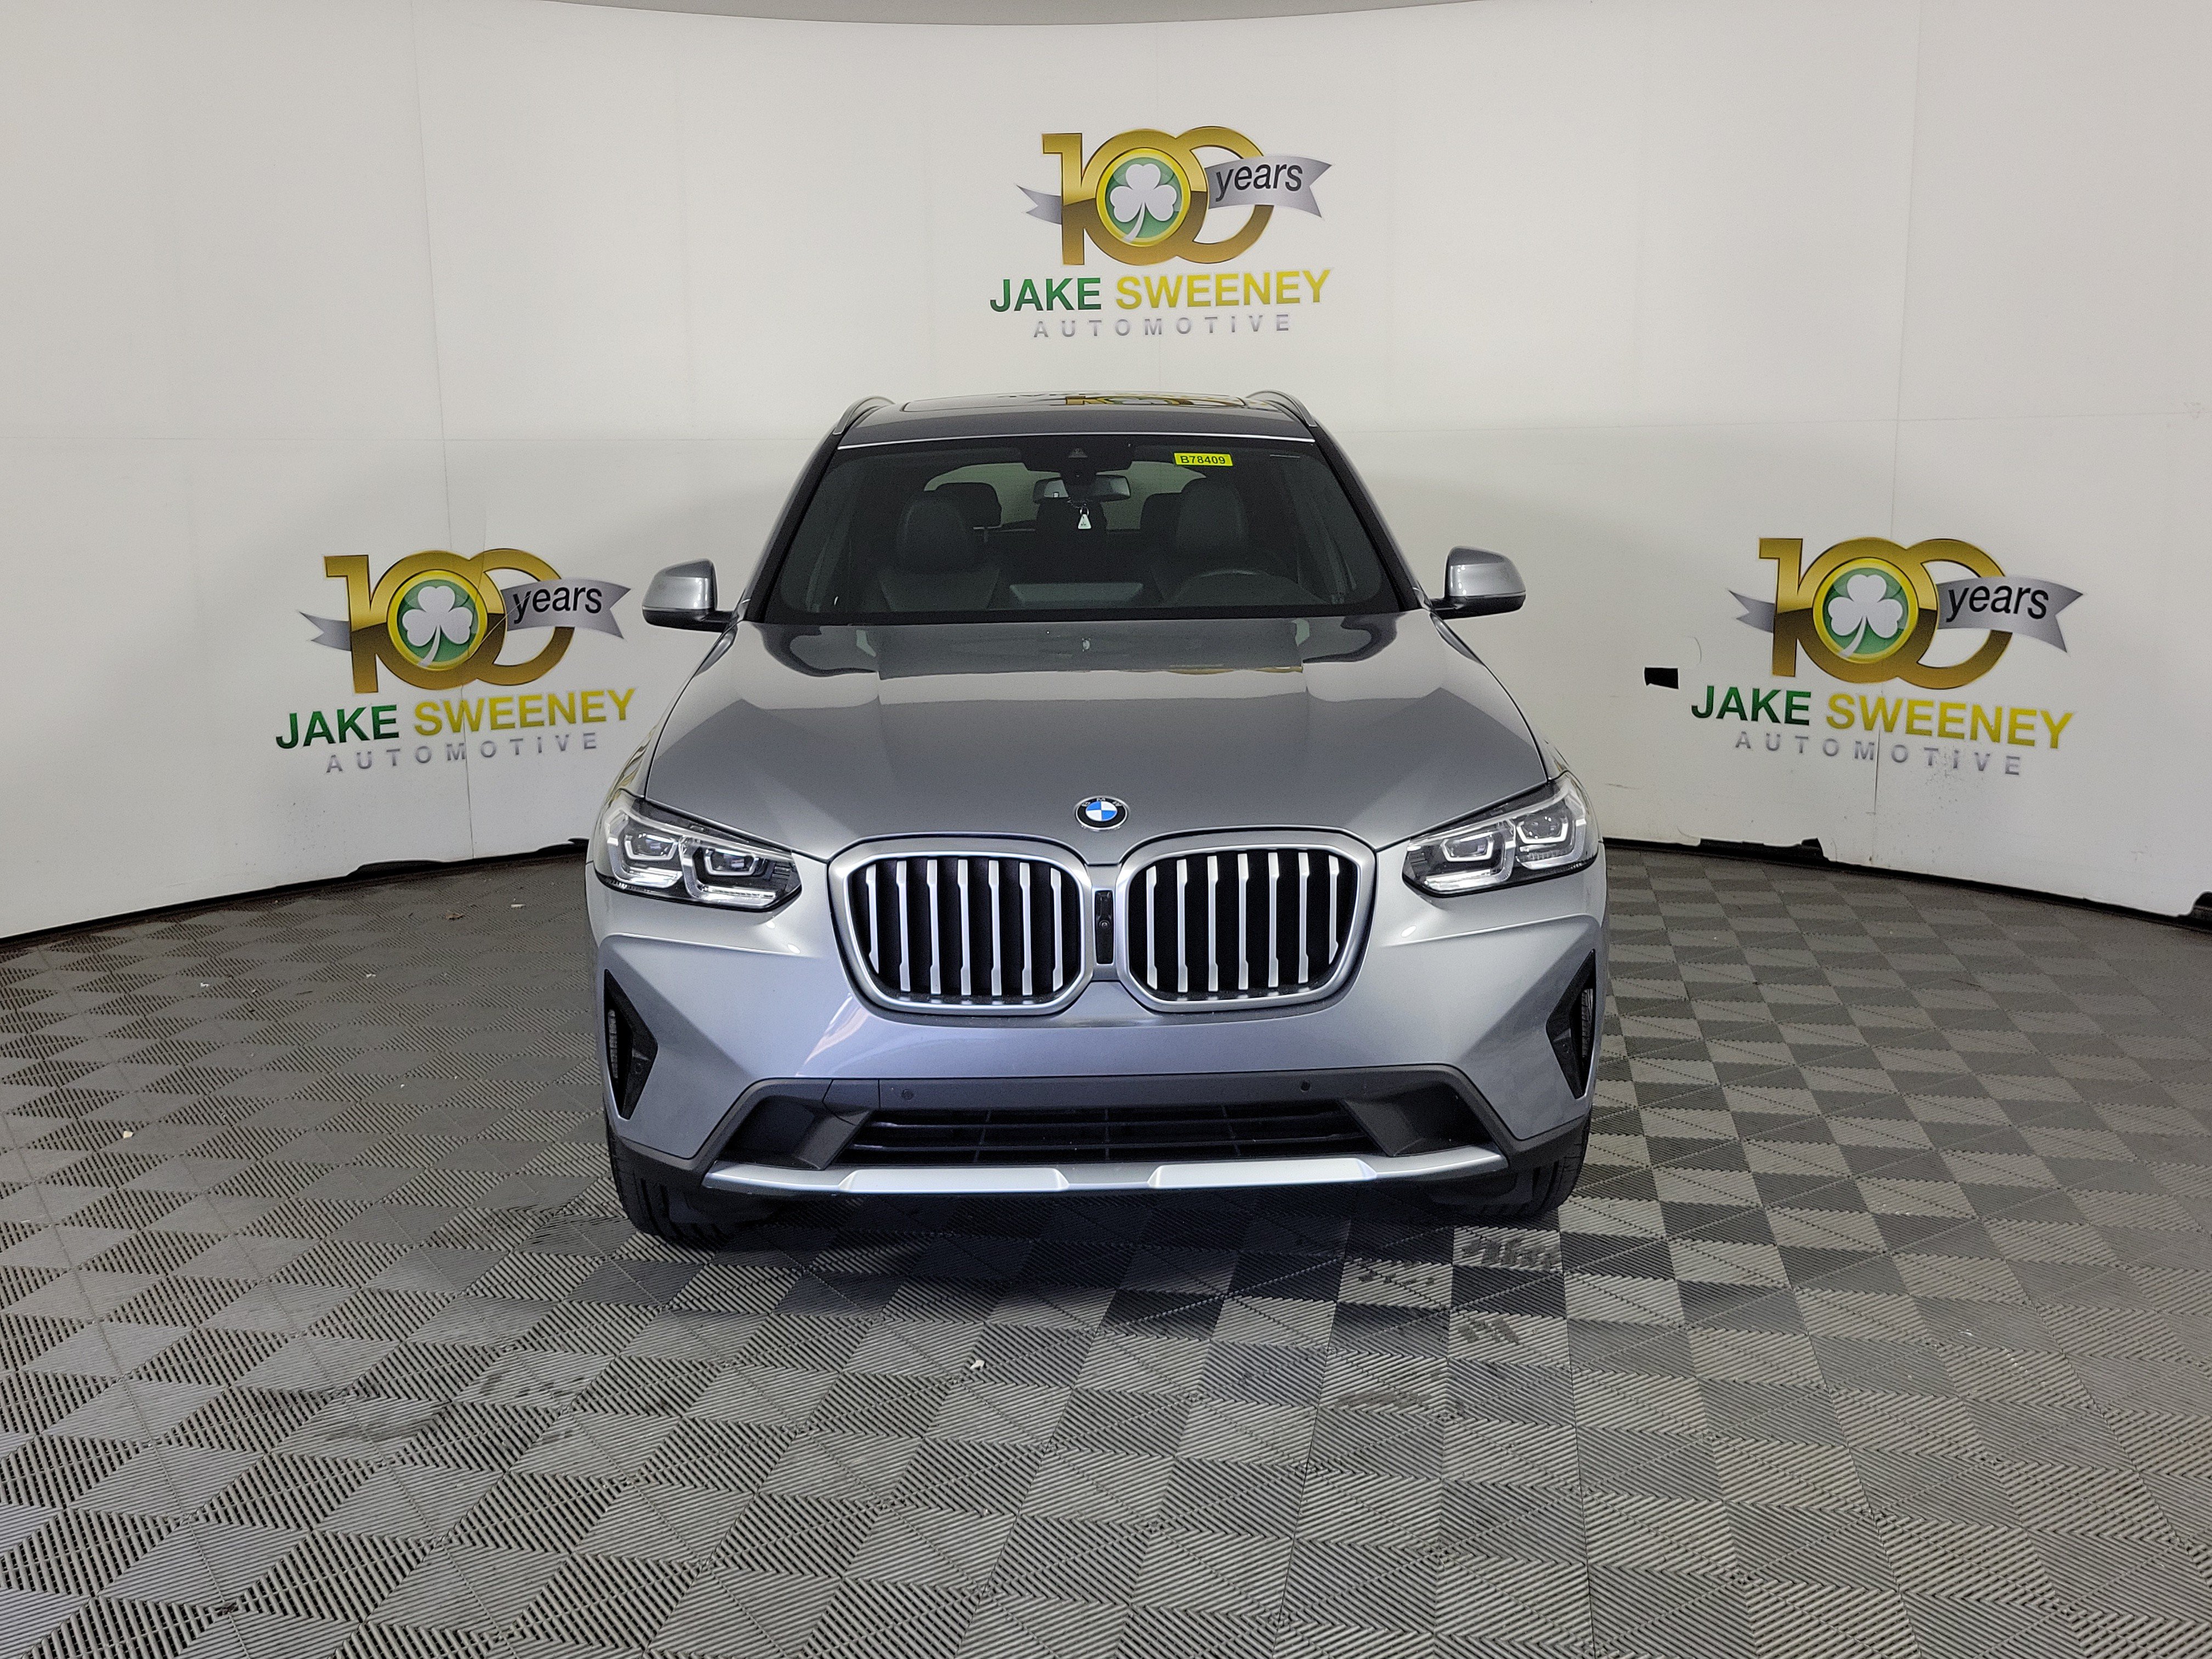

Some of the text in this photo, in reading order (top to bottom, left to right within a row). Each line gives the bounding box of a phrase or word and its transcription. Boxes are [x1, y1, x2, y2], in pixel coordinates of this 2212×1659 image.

[1041, 126, 1274, 266] 100
[1215, 163, 1304, 201] years
[990, 269, 1331, 312] JAKE SWEENEY
[1034, 314, 1290, 337] AUTOMOTIVE
[1180, 455, 1226, 464] B78409
[324, 548, 575, 693] 100
[513, 586, 602, 624] years
[1759, 537, 2013, 690] 100
[1945, 585, 2049, 622] years
[276, 688, 636, 749] JAKE SWEENEY
[1691, 685, 2075, 749] JAKE SWEENEY
[326, 732, 597, 774] AUTOMOTIVE
[1735, 731, 2021, 776] AUTOMOTIVE
